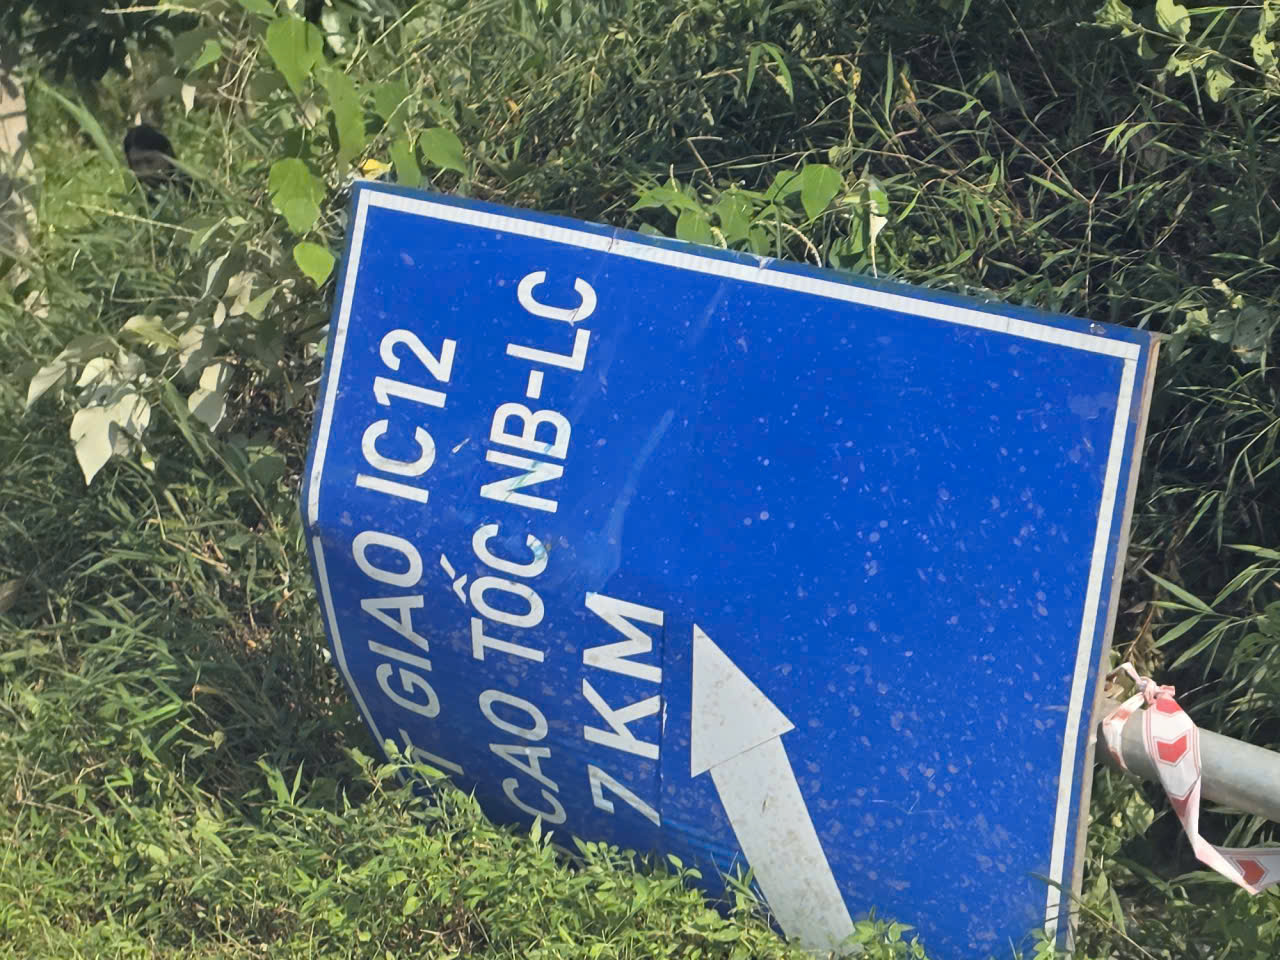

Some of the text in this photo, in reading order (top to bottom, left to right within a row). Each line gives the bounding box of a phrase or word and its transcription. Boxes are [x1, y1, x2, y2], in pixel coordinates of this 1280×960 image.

[355, 328, 457, 505] IC12
[352, 530, 441, 718] GIAO
[439, 270, 597, 825] CAO TỐC NB-LC
